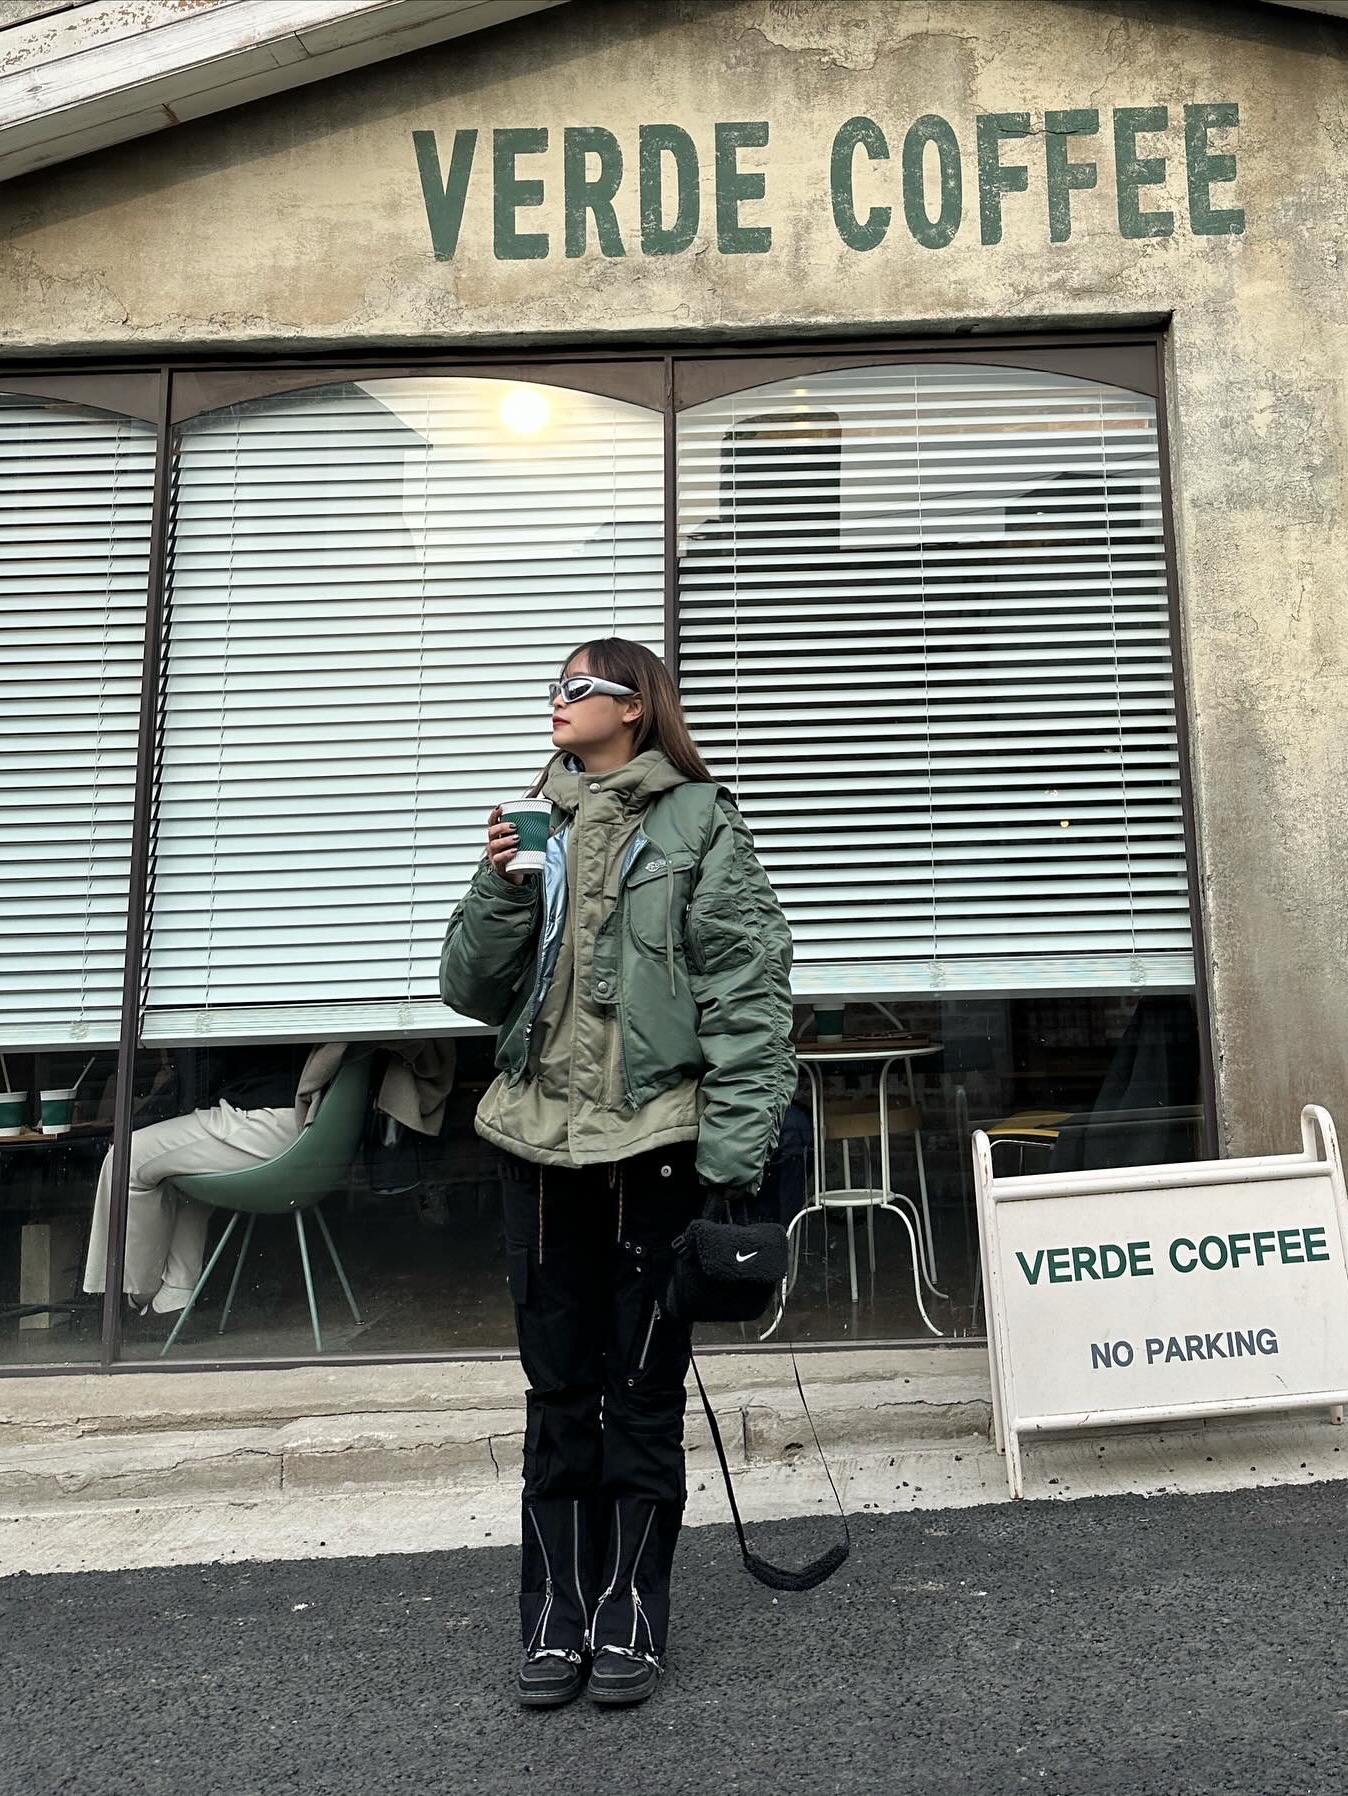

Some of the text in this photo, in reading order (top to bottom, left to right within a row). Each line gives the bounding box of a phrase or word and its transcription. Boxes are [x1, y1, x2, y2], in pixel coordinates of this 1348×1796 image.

[412, 103, 1245, 261] VERDE COFFEE
[1015, 1226, 1331, 1286] VERDE COFFEE
[1090, 1328, 1279, 1370] NO PARKING
